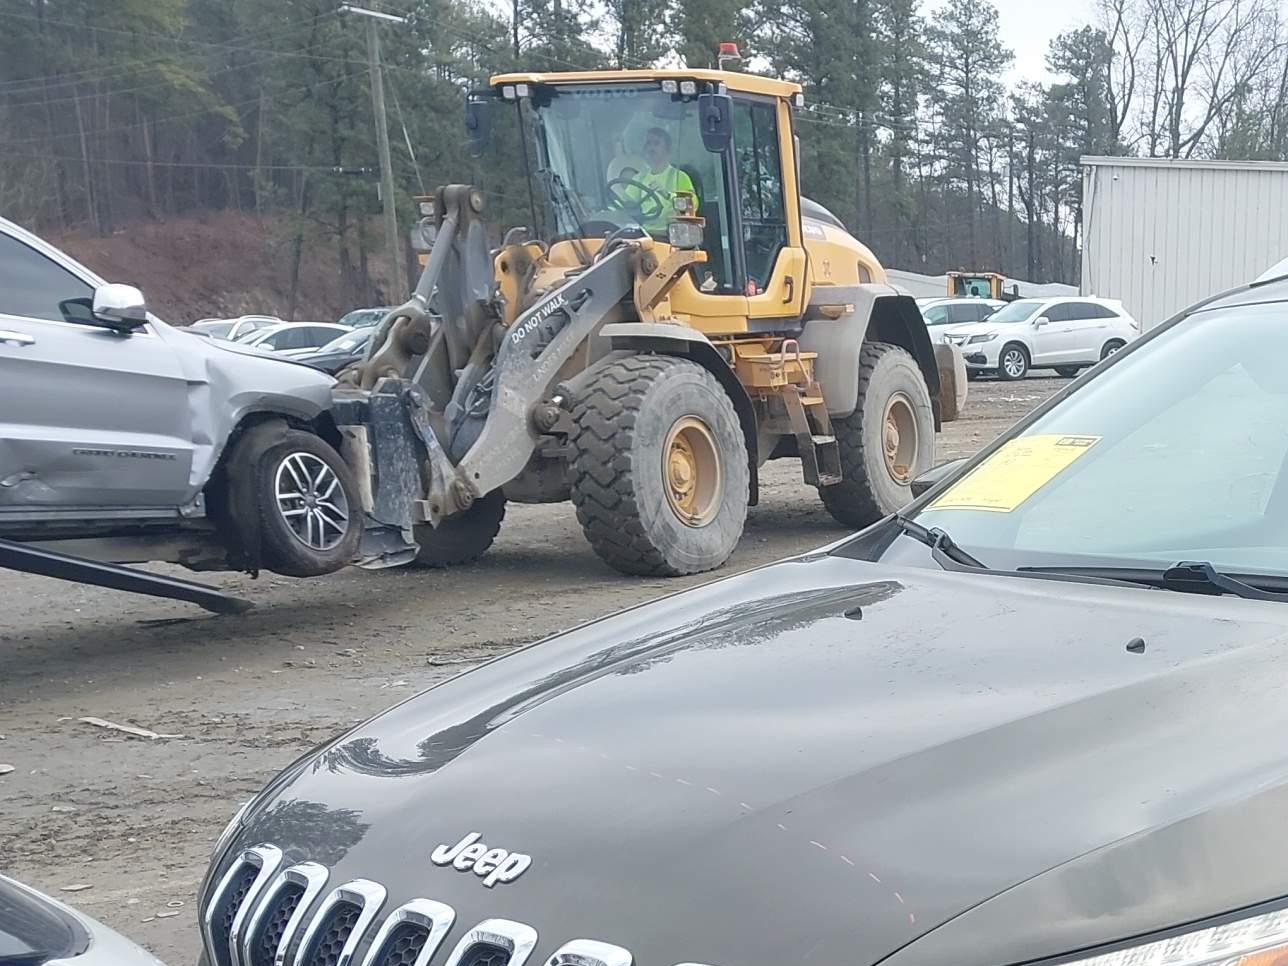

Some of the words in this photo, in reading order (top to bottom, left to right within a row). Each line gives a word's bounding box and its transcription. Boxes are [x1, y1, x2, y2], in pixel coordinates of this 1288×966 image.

[512, 328, 526, 344] DO
[524, 314, 544, 333] NOT
[544, 294, 566, 316] WALK
[431, 832, 532, 888] Jeep
